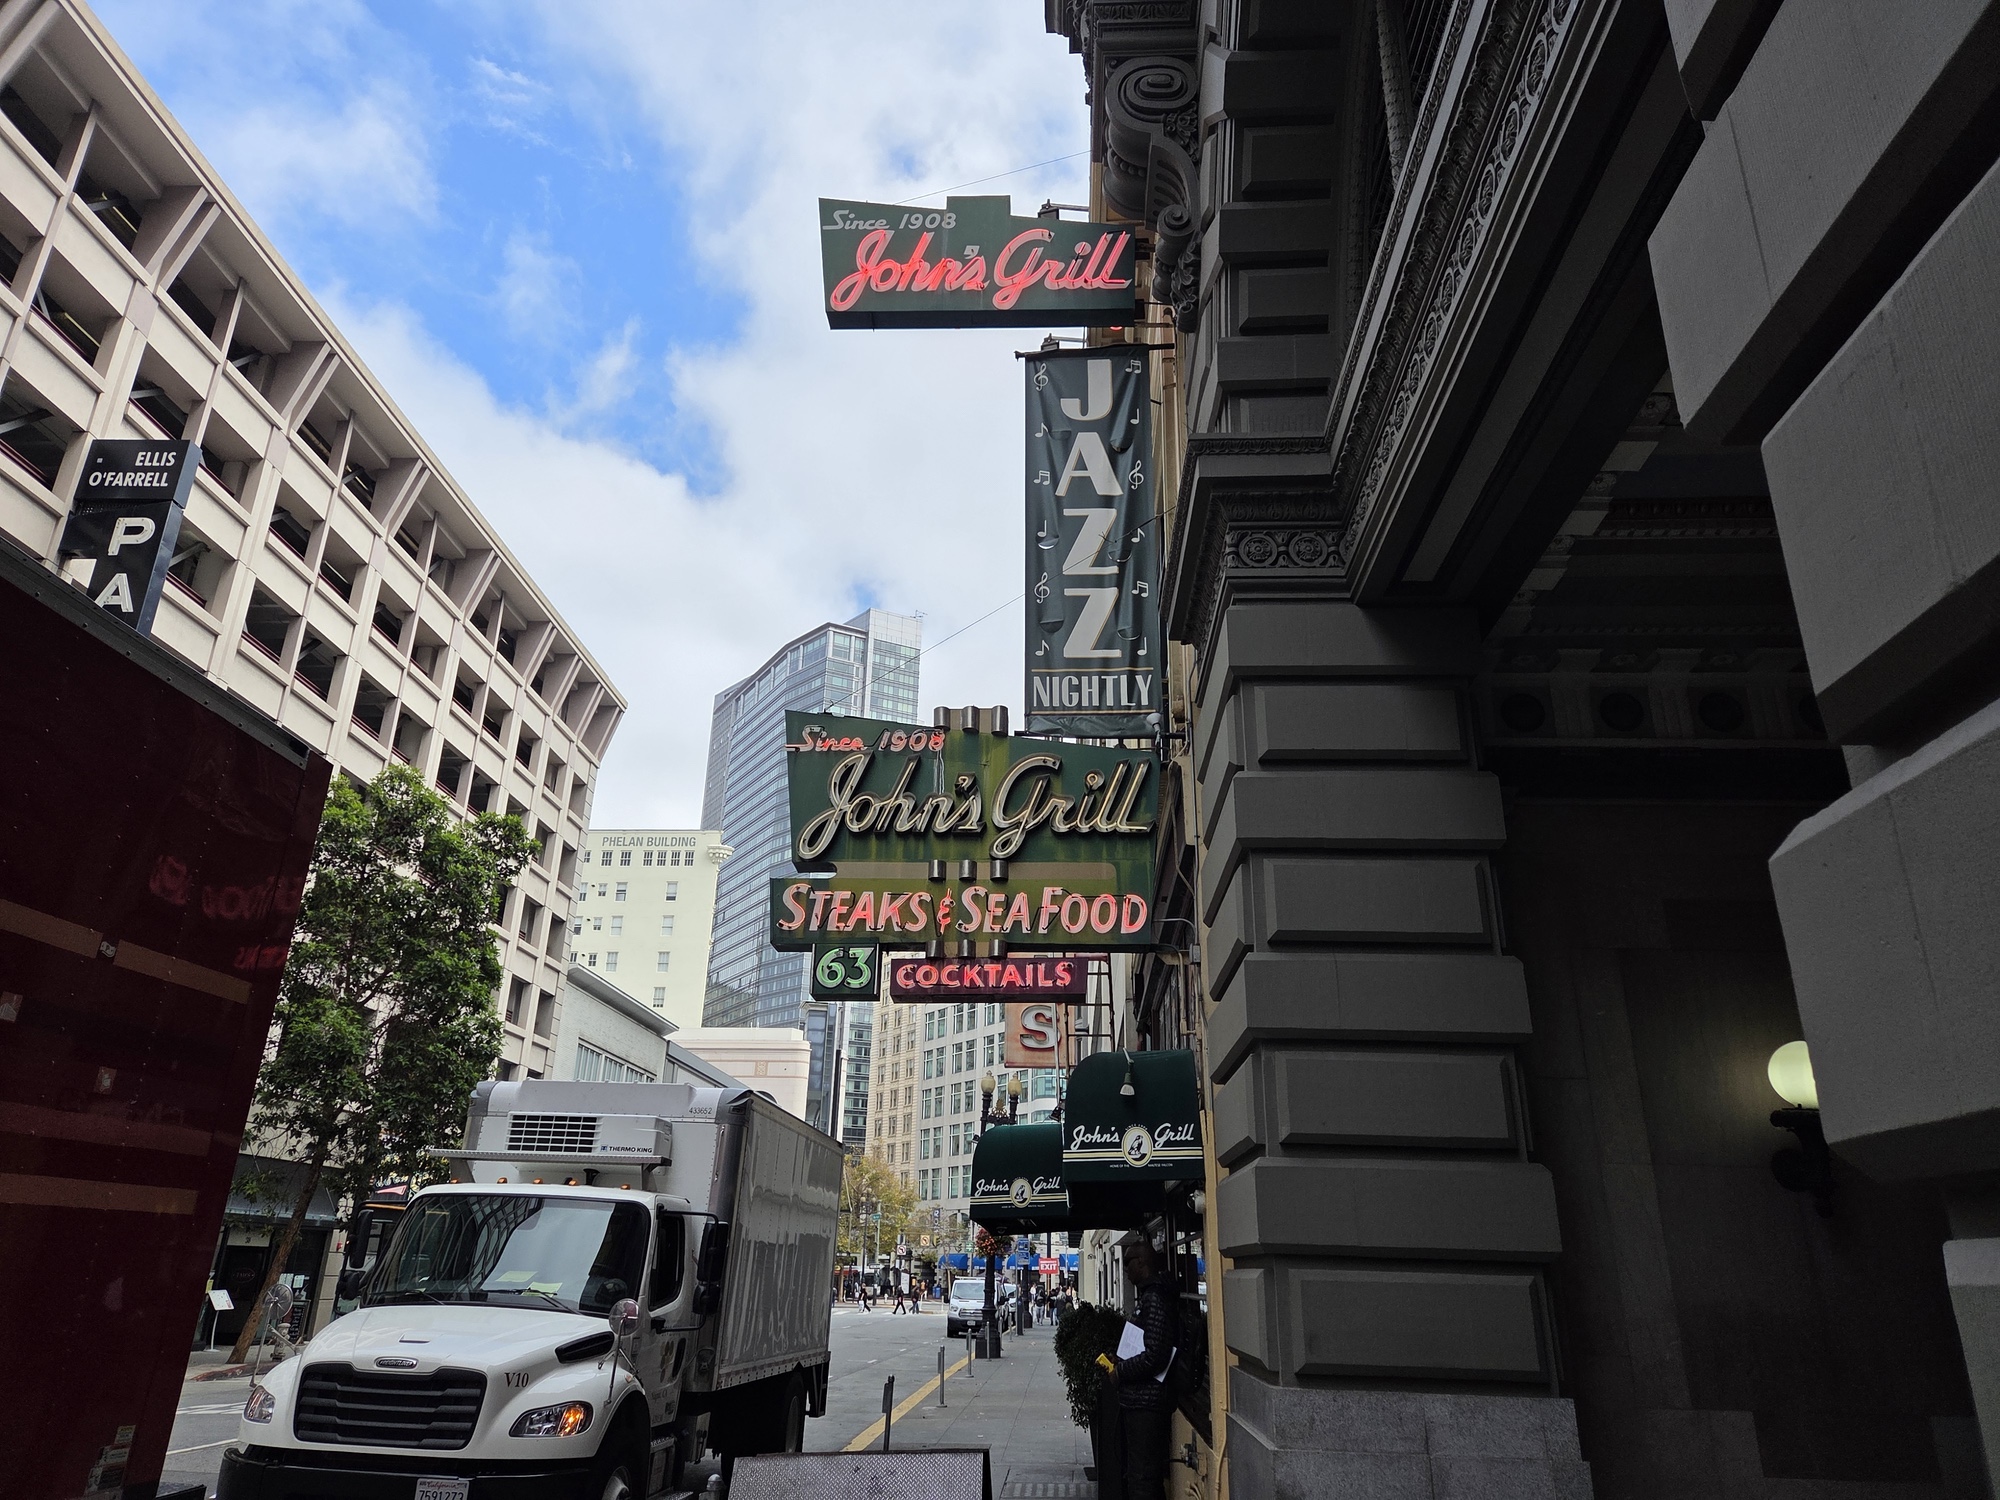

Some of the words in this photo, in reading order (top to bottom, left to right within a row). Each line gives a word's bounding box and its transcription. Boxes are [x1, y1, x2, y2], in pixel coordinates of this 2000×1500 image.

[822, 209, 890, 230] Since
[899, 213, 957, 230] 1908
[830, 229, 990, 311] John's
[992, 228, 1132, 310] Grill
[135, 451, 177, 467] ELLIS
[88, 471, 169, 487] O'FARRELL
[1055, 358, 1124, 659] JAZZ
[1033, 674, 1153, 707] NIGHTLY
[785, 725, 865, 752] Since
[880, 728, 946, 752] 1908
[797, 750, 987, 862] John's
[989, 752, 1157, 861] Grill
[602, 836, 644, 847] PHELAN
[646, 836, 697, 847] BUILDING
[777, 883, 932, 933] STEAKS
[937, 887, 956, 935] &
[815, 947, 874, 989] 63
[895, 961, 1074, 990] COCKTAILS
[689, 1107, 713, 1115] 433652
[1070, 1125, 1120, 1151] John's
[1154, 1122, 1195, 1148] Grill
[974, 1179, 1009, 1197] John's
[1032, 1176, 1061, 1195] Grill
[1040, 1263, 1057, 1271] EXIT
[505, 1372, 529, 1388] V10
